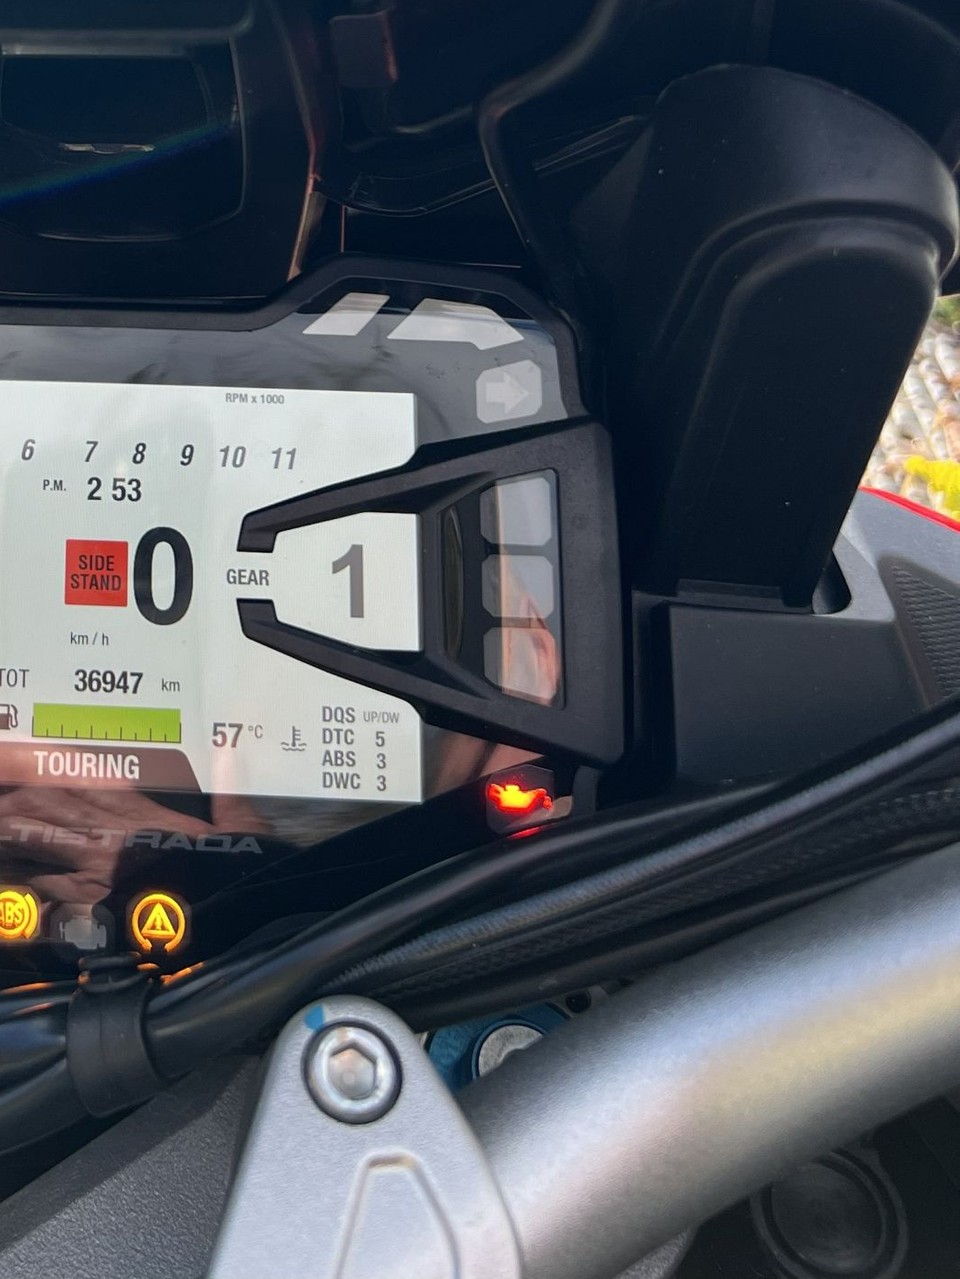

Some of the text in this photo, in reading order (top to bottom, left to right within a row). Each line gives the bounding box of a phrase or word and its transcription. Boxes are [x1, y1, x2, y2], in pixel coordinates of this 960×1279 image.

[225, 392, 249, 404] RPM
[260, 394, 285, 405] 1000
[21, 438, 36, 461] 6
[84, 440, 99, 463] 7
[132, 442, 147, 465] 8
[179, 444, 195, 467] 9
[219, 445, 247, 469] 10
[271, 447, 297, 470] 11
[42, 476, 142, 503] P.M. 2 53
[78, 554, 116, 571] SIDE
[70, 573, 123, 591] STAND
[132, 526, 194, 626] 0
[226, 568, 270, 587] GEAR
[331, 543, 365, 619] 1
[74, 668, 144, 695] 36947
[161, 678, 181, 692] km
[321, 705, 400, 725] DQS UP/DW
[211, 721, 244, 749] 57
[322, 727, 386, 748] DTC 5
[34, 750, 140, 780] TOURING
[321, 749, 387, 770] ABS 3
[322, 771, 387, 792] DWC 3
